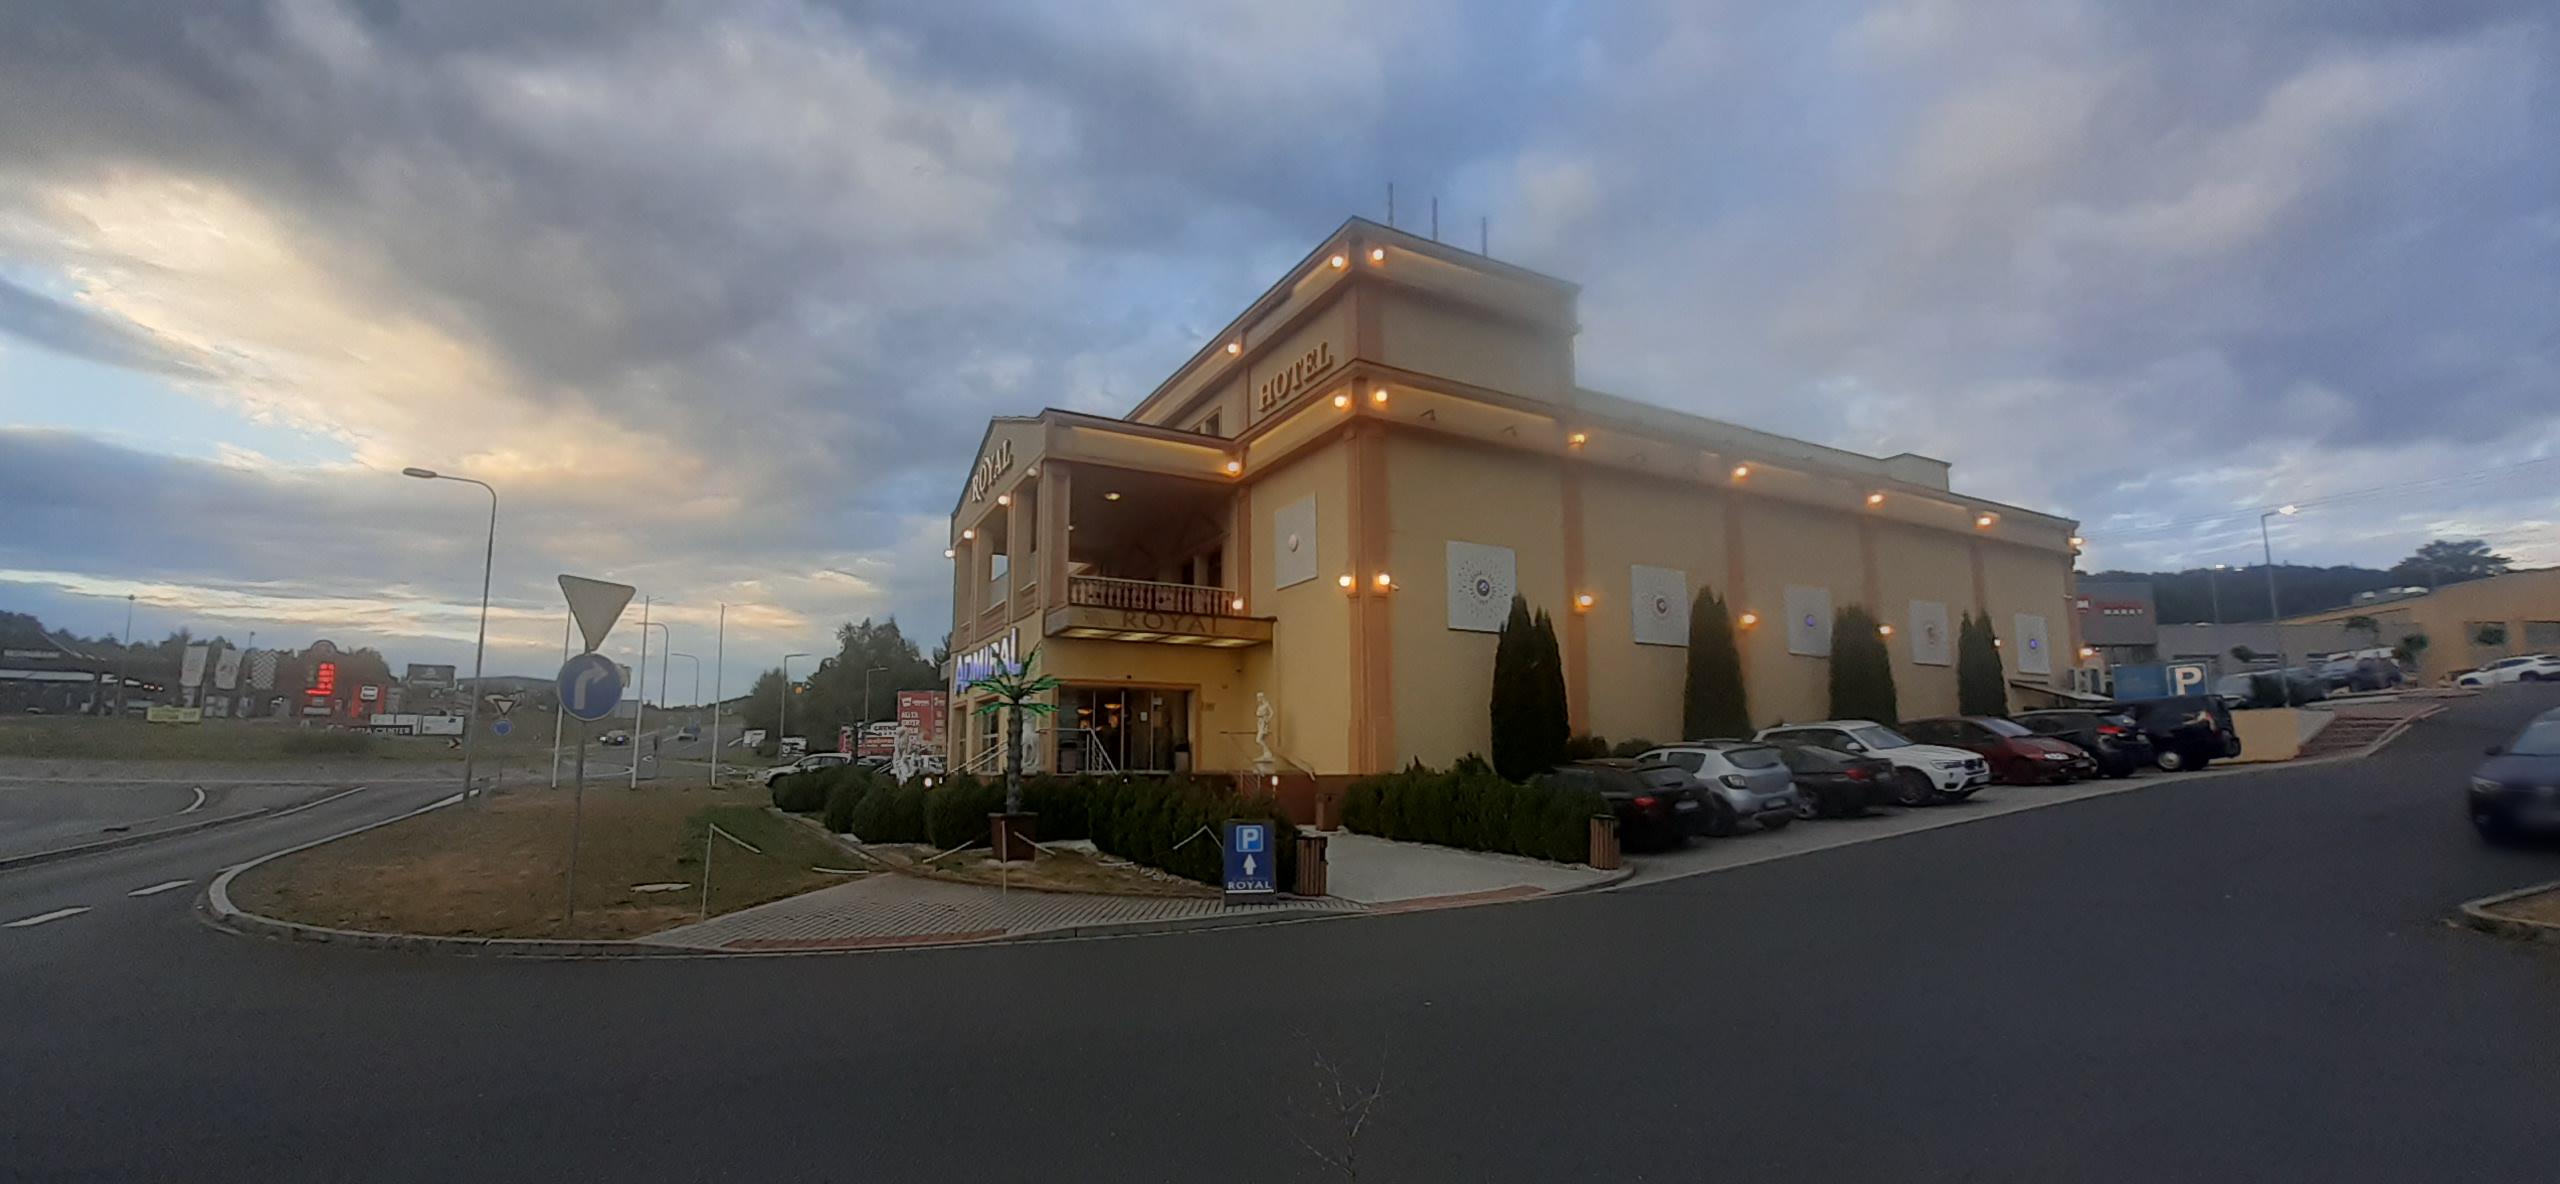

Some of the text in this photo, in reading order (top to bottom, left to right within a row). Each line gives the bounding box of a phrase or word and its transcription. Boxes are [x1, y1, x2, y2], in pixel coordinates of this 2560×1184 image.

[1259, 342, 1334, 412] HOTEL
[972, 439, 1012, 502] ROYAL
[1123, 611, 1217, 634] ROYAL
[954, 627, 1023, 695] ADMIRAL
[2175, 667, 2202, 696] P
[1242, 828, 1259, 849] P
[1228, 881, 1272, 890] ROYAL
